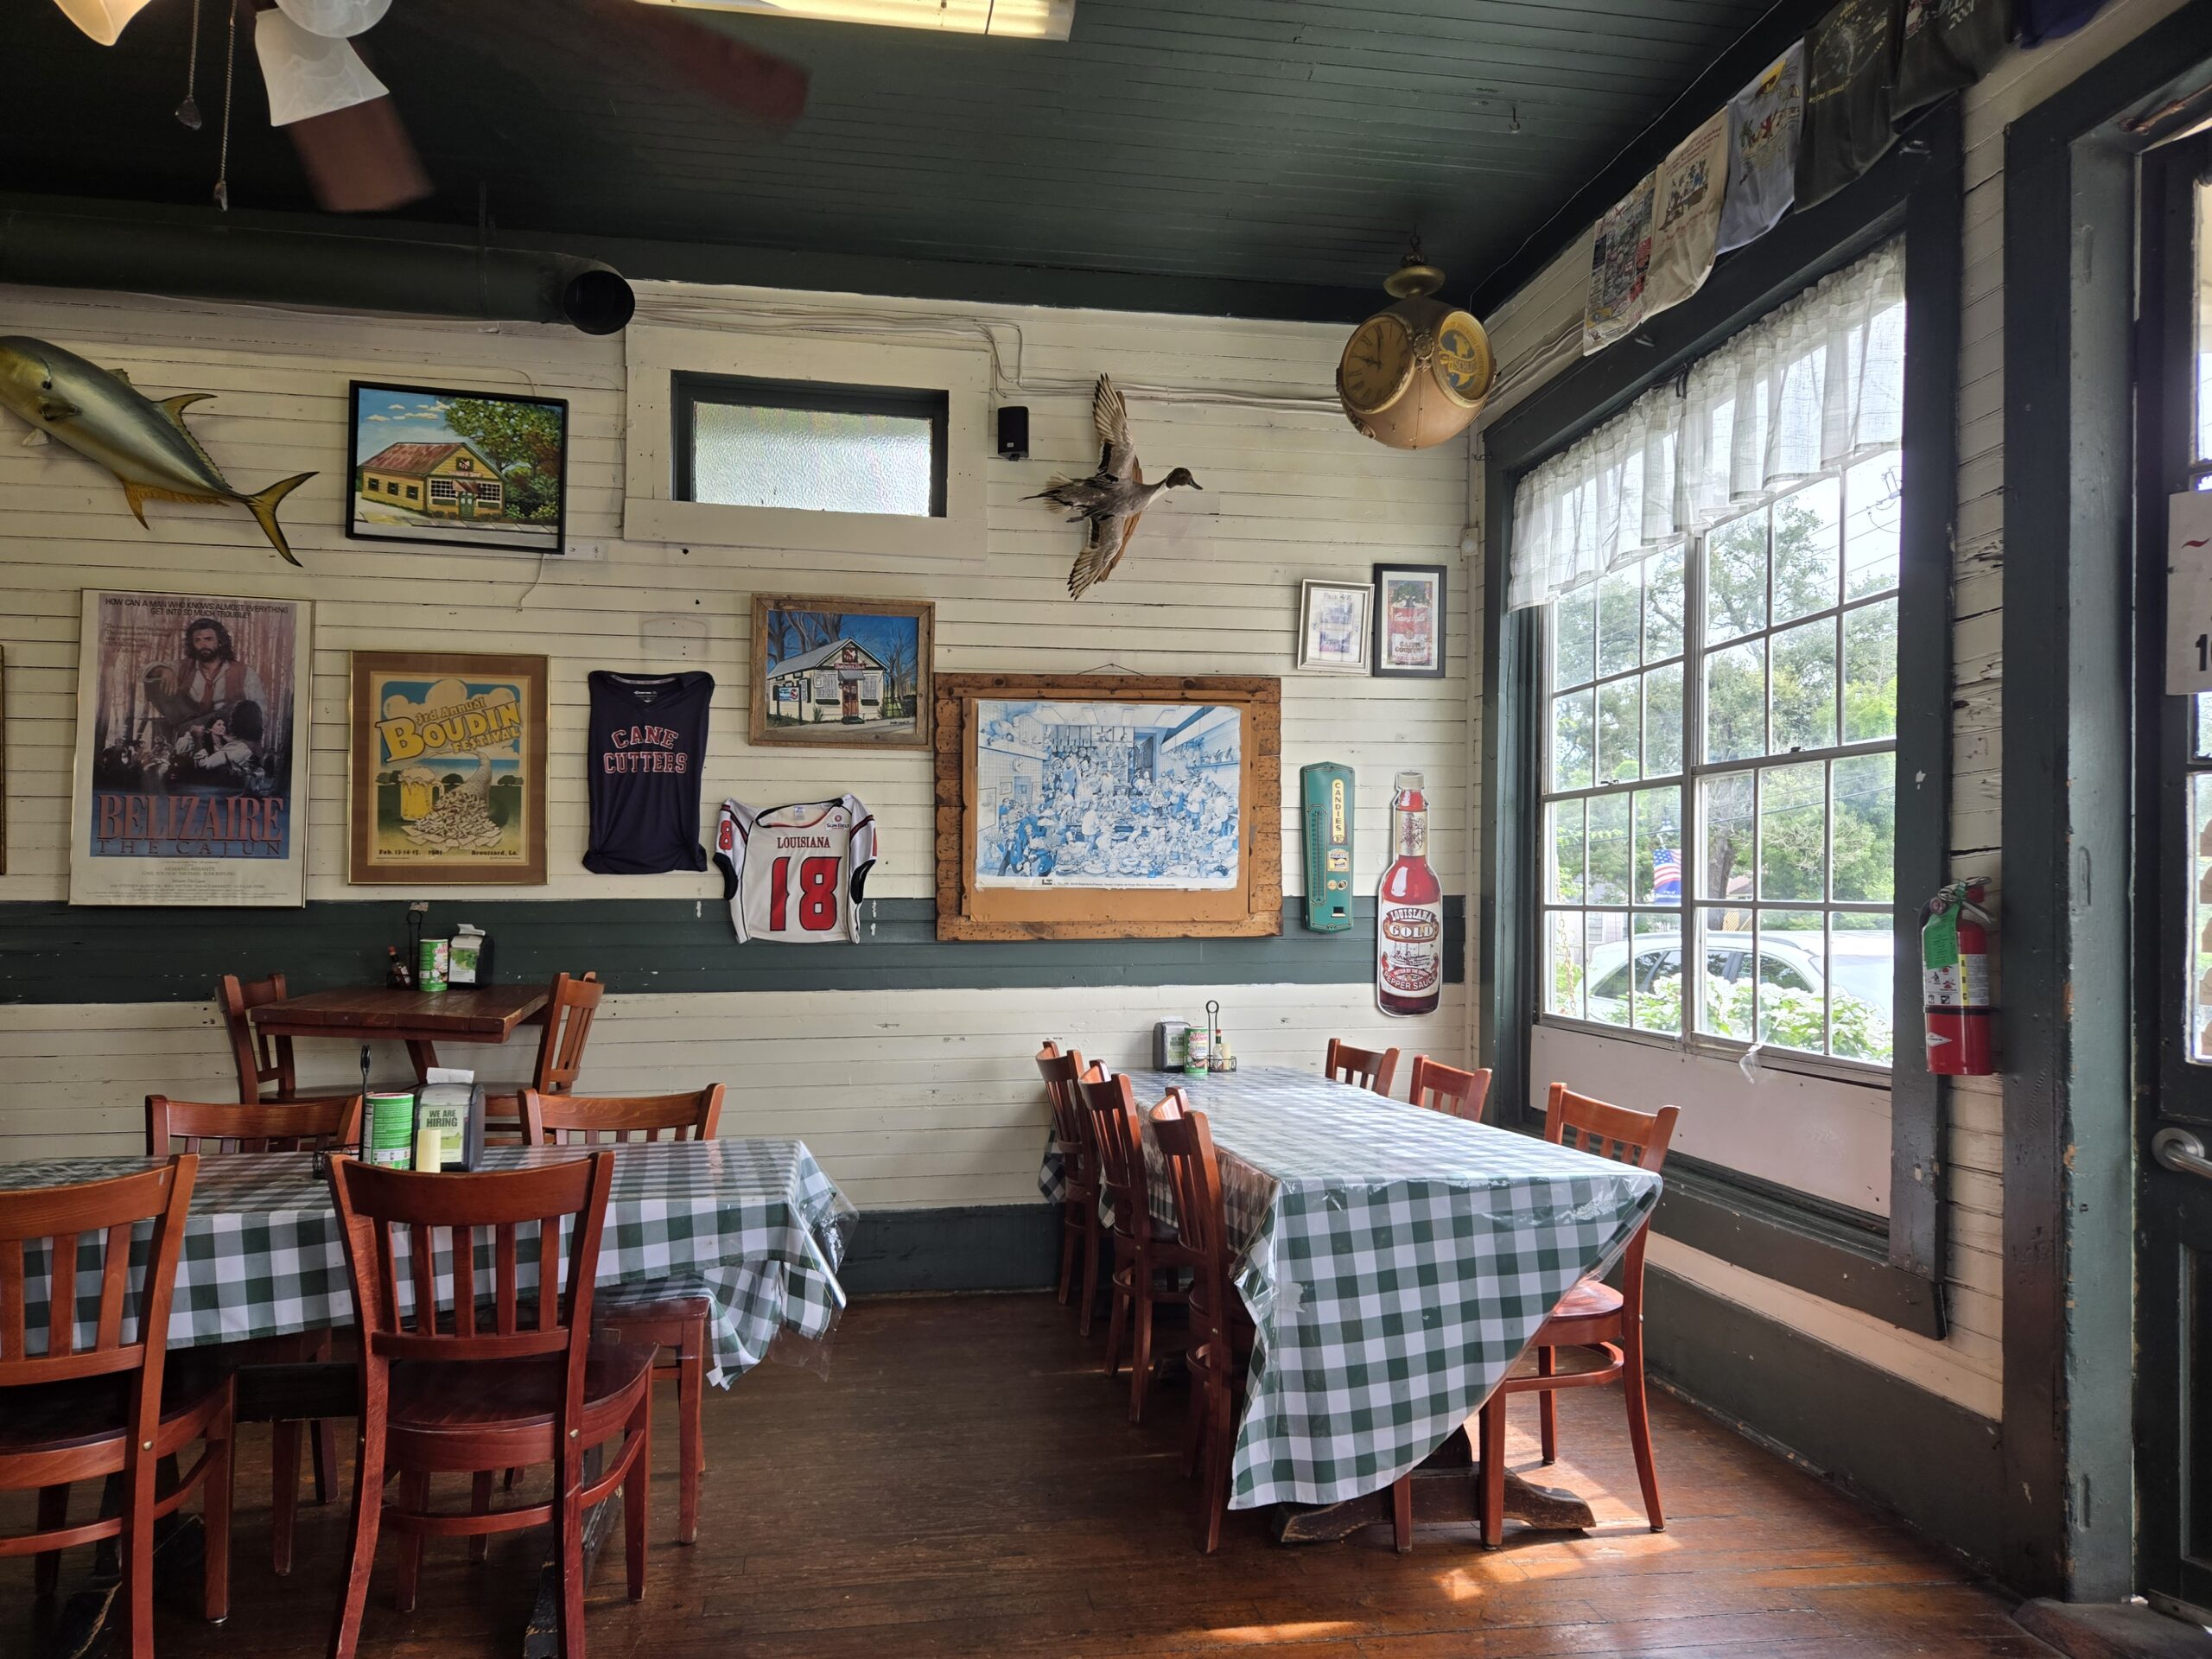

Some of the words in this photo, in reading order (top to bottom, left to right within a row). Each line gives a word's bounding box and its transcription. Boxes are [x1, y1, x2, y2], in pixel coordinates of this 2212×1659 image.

[187, 601, 213, 610] KNOWS
[216, 603, 244, 612] ALMOST
[245, 604, 289, 614] EVERYTHING
[217, 610, 251, 620] TROUBLE?
[415, 709, 438, 726] 3rd
[440, 697, 487, 718] Annual
[374, 701, 521, 763] BOUDIN
[451, 725, 521, 753] FESTIVAL
[612, 725, 679, 749] CANE
[603, 751, 688, 773] CUTTERS
[97, 794, 283, 843] BELIZAIRE
[97, 841, 160, 854] THE
[175, 842, 281, 858] CAJUN
[777, 836, 830, 849] LOUISIANA
[770, 856, 842, 931] 18
[1390, 908, 1432, 922] LOUISIANA
[1389, 925, 1433, 938] GOLD
[1384, 970, 1410, 990] PEPPER
[1414, 973, 1437, 990] SAUCE
[426, 1118, 458, 1127] HIRING
